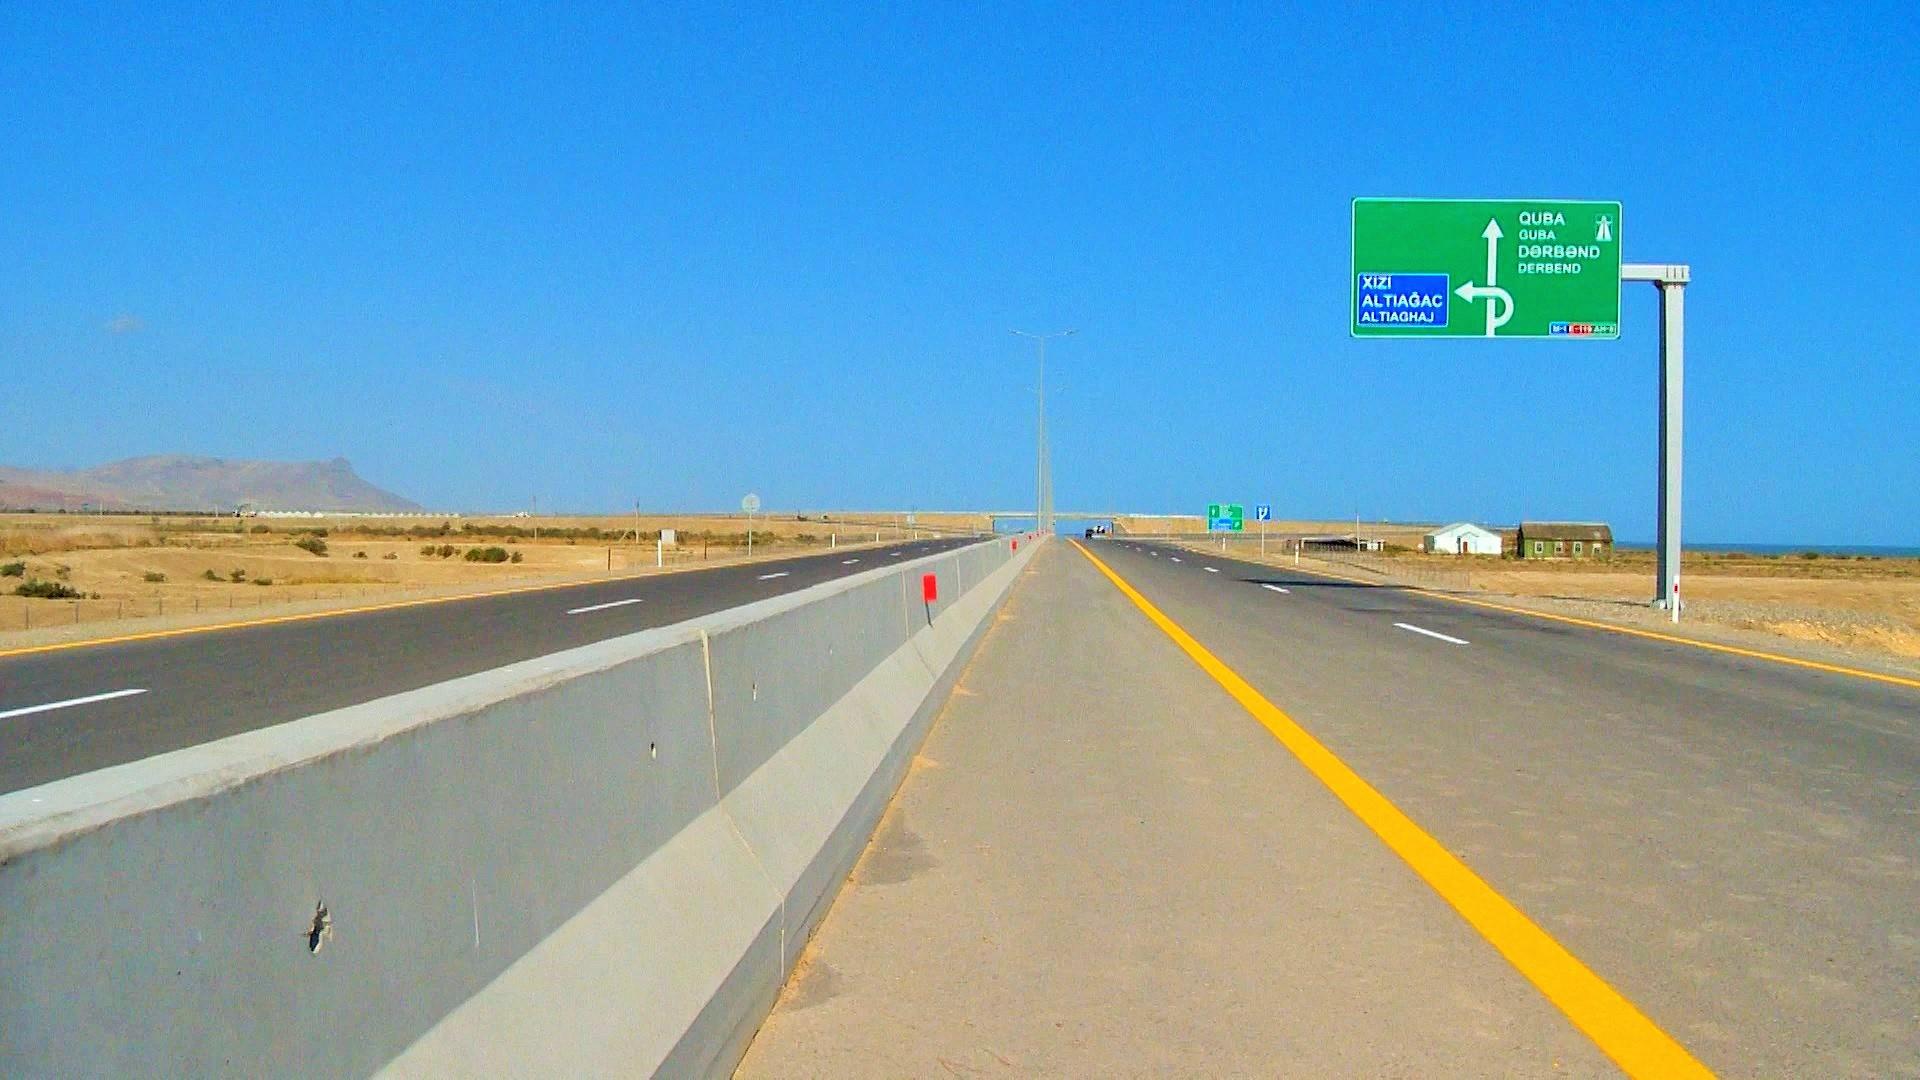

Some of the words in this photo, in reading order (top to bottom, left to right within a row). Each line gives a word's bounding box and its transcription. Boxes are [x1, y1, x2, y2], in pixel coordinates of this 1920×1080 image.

[1519, 211, 1566, 226] QUBA
[1519, 229, 1556, 240] GUBA
[1518, 263, 1581, 274] DERBEND
[1361, 291, 1443, 308] ALTIAĞAC
[1361, 311, 1435, 322] ALTIAGHAJ
